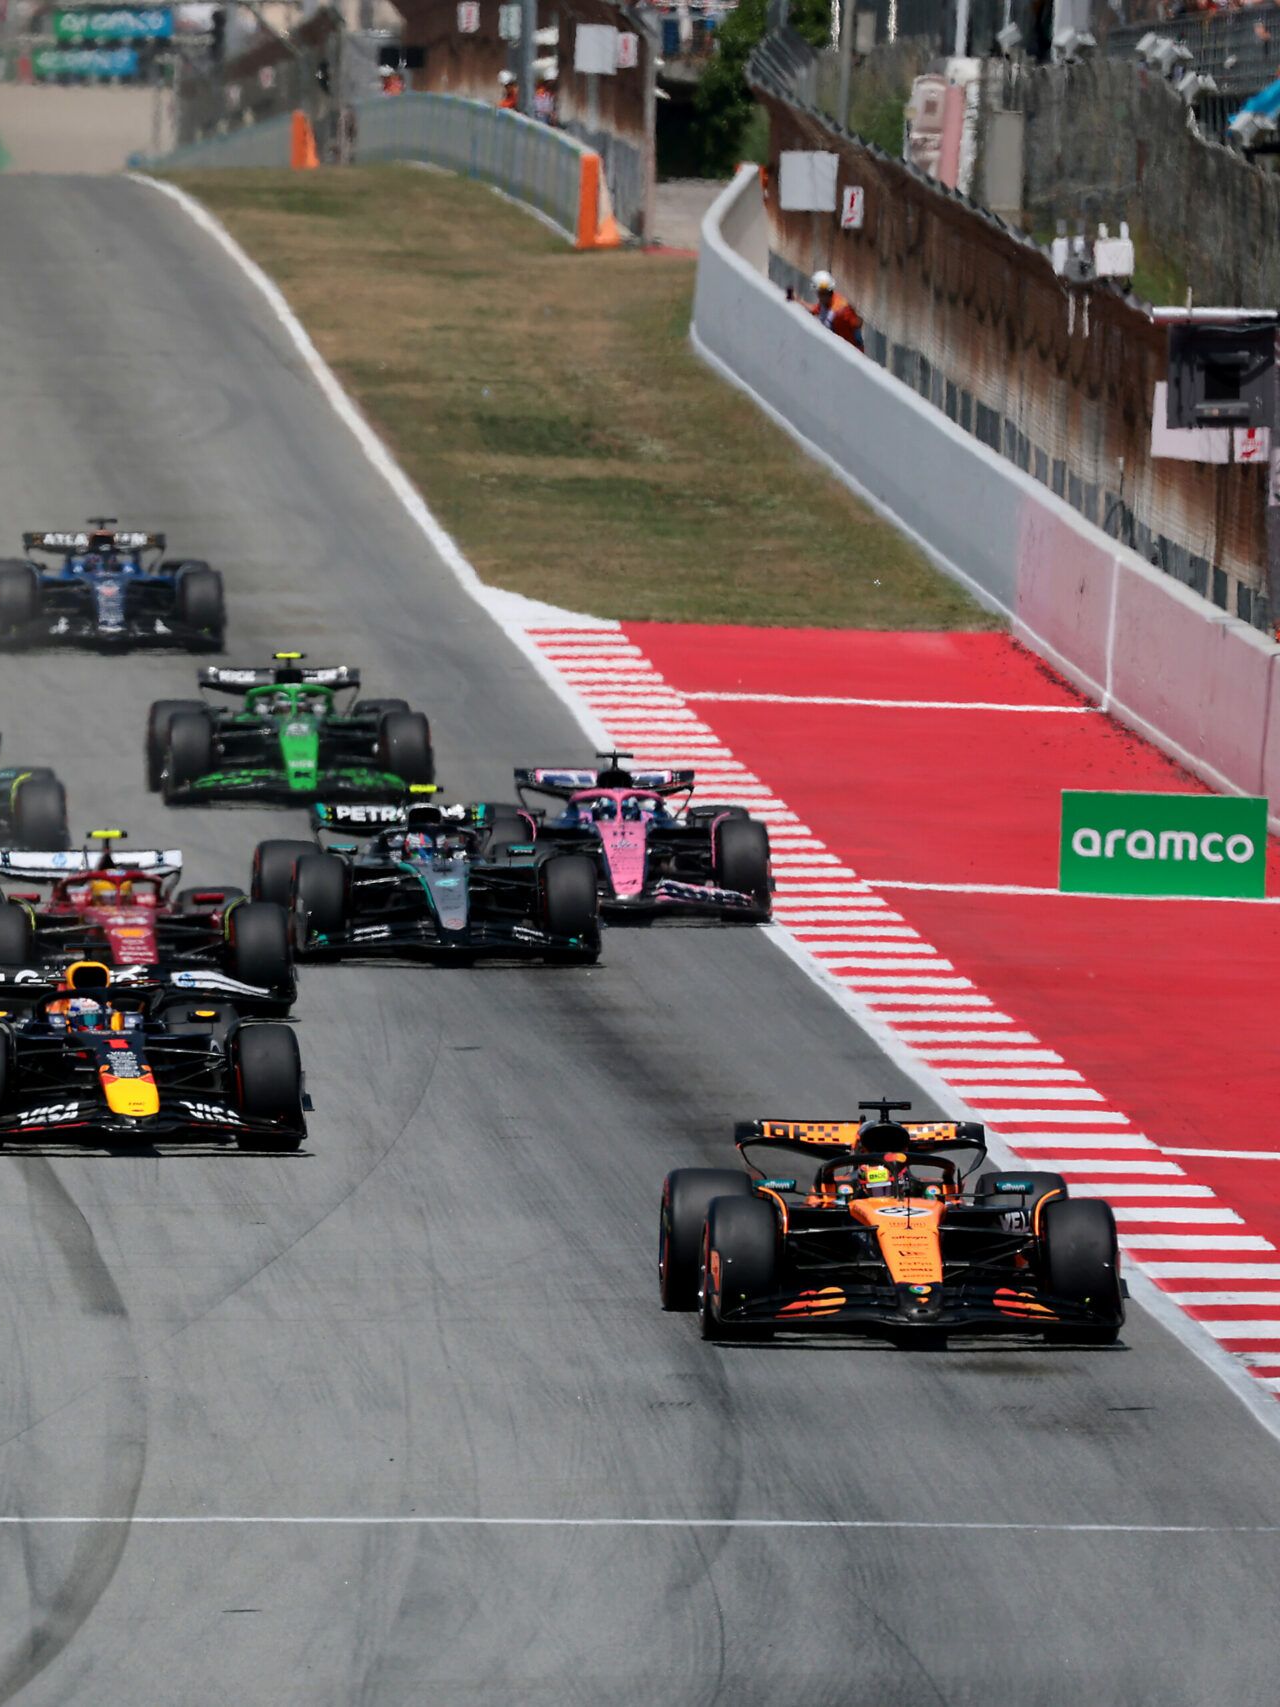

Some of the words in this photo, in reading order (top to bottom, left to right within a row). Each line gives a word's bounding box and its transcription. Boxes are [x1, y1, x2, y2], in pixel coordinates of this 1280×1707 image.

[1072, 828, 1254, 863] aramco
[17, 1102, 80, 1126] VISA
[1001, 1183, 1026, 1193] allwyn
